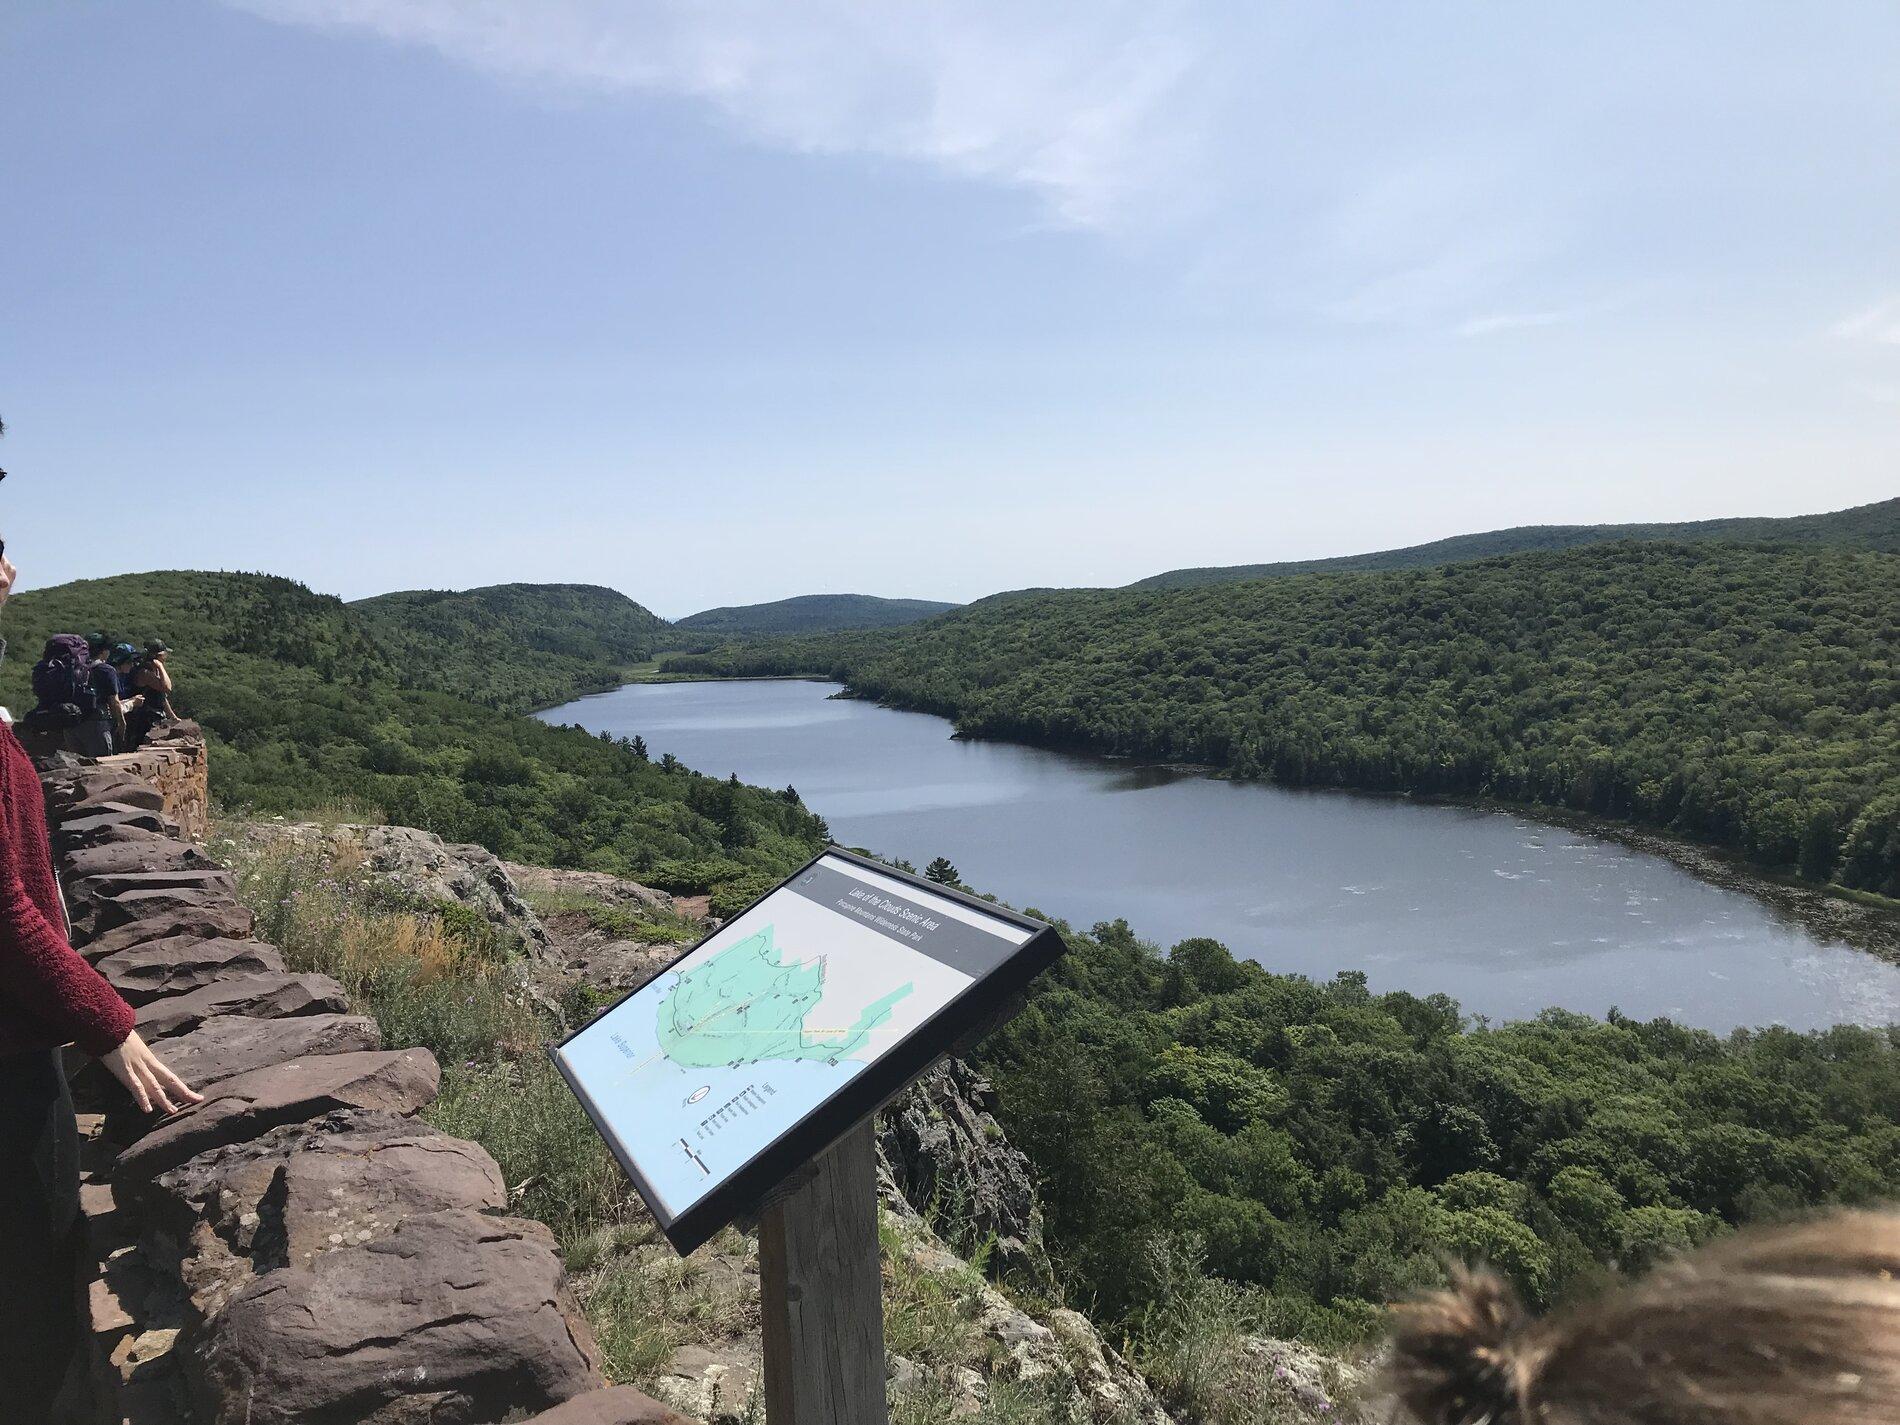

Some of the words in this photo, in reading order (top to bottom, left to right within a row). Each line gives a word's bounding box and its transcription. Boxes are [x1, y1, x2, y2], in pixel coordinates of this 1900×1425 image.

[849, 887, 866, 899] Lake
[861, 893, 876, 901] of
[868, 895, 881, 906] the
[878, 899, 902, 915] Clouds
[898, 907, 923, 924] Scenic
[919, 917, 940, 931] Area
[896, 926, 911, 937] State
[909, 931, 923, 942] Park
